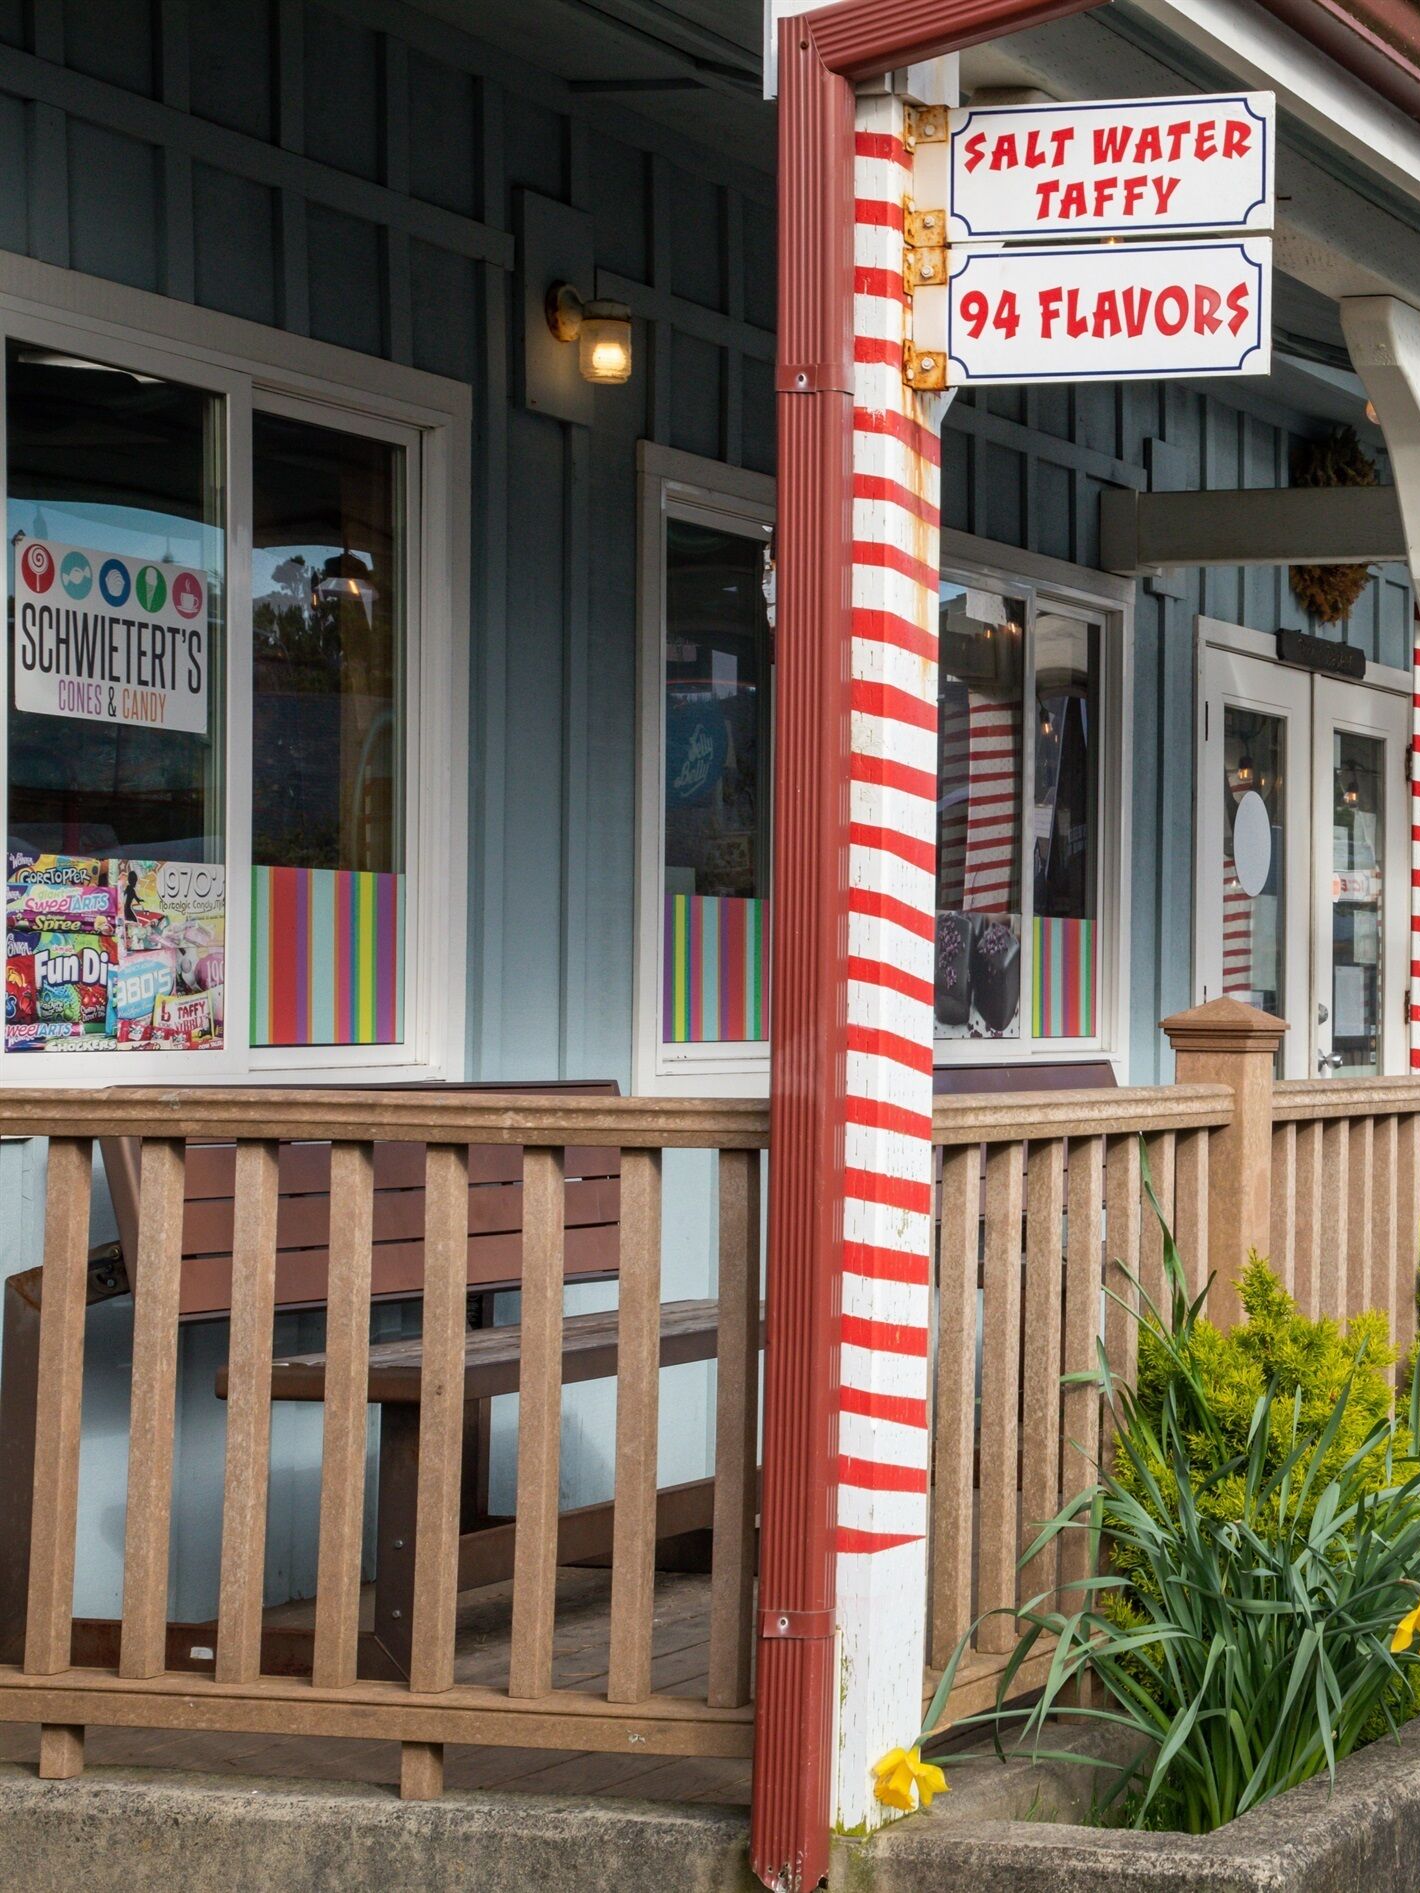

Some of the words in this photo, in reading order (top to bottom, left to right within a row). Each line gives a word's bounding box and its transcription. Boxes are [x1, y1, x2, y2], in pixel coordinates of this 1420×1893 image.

[964, 127, 1074, 173] SALT
[1093, 120, 1251, 165] WATER
[1036, 175, 1181, 220] TAFFY
[960, 290, 1020, 340] 94
[1039, 282, 1249, 339] FLAVORS
[22, 602, 201, 694] SCHWIETERT'S
[58, 679, 101, 715] CONES
[107, 686, 117, 717] &
[122, 688, 166, 723] CANDY
[33, 915, 82, 931] Spree
[34, 949, 80, 990] Fun
[82, 948, 108, 986] Di
[6, 1022, 73, 1038] weeTARTS
[177, 1001, 205, 1020] TAFFY
